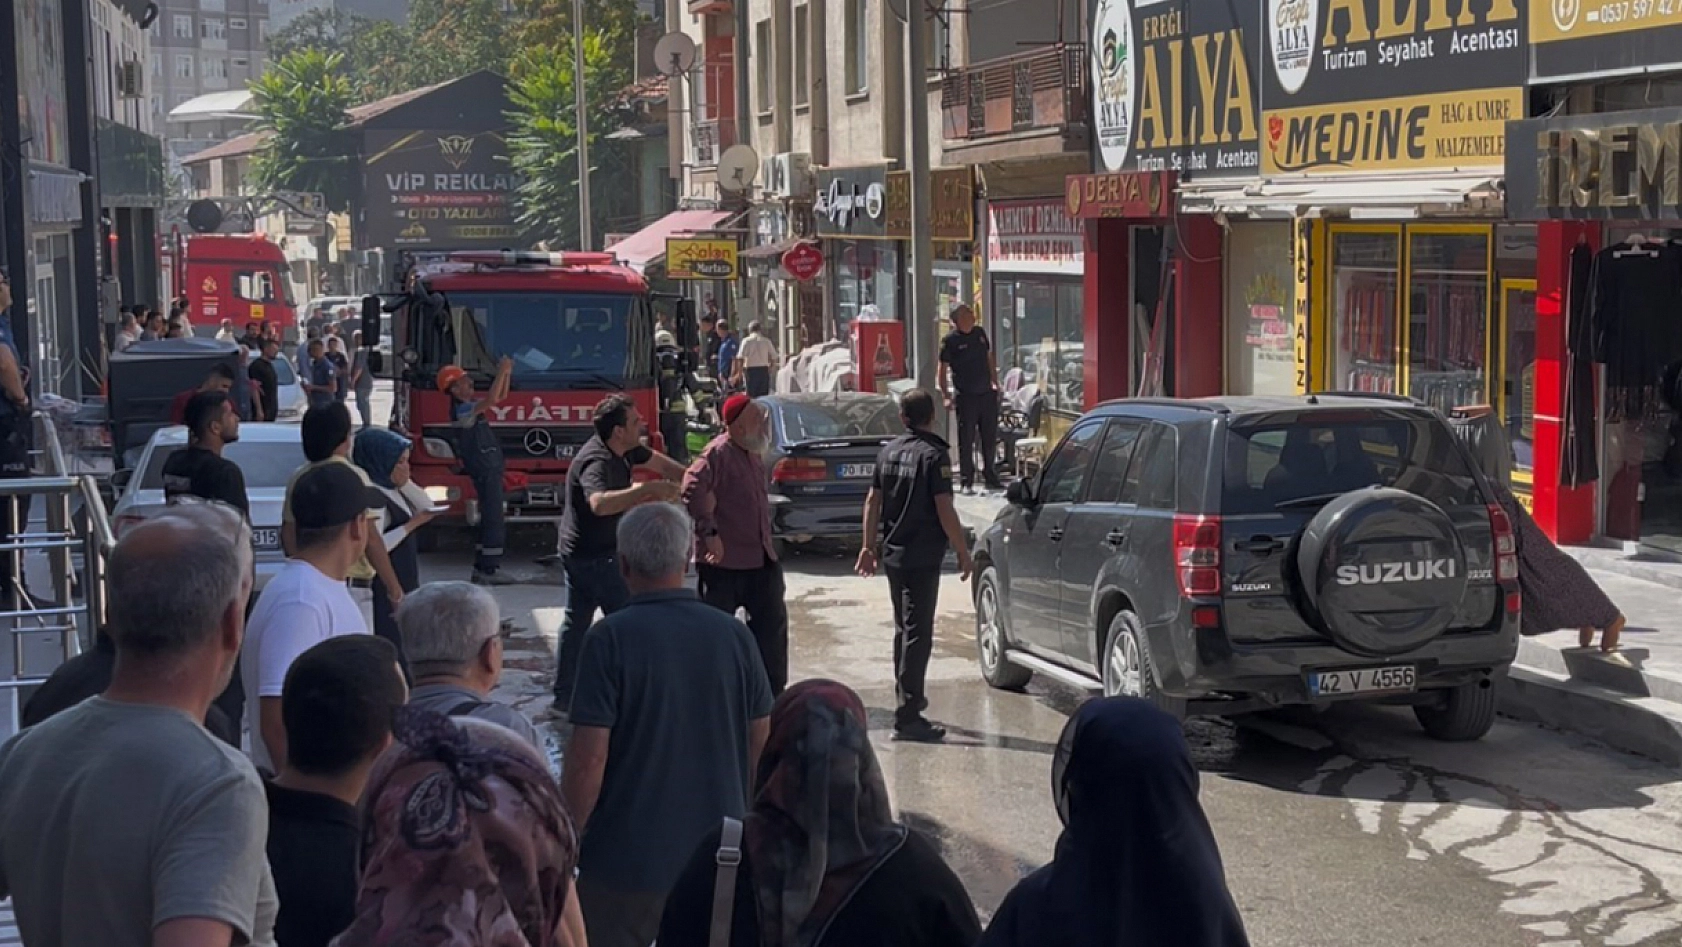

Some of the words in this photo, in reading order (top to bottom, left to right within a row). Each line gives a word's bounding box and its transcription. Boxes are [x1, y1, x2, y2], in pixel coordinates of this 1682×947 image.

[1143, 7, 1186, 41] EREĞL
[1277, 24, 1310, 51] ALYA
[1323, 48, 1367, 71] Turizm
[1378, 36, 1434, 67] Seyahat
[1450, 26, 1519, 54] Acentası
[1136, 27, 1258, 150] ALYA
[1441, 101, 1465, 124] HAC
[1476, 99, 1511, 121] UMRE
[1216, 149, 1258, 168] Acentası
[1435, 134, 1504, 159] MALZEMELE
[1085, 174, 1142, 203] DERYA
[408, 207, 439, 219] OTO
[1336, 558, 1456, 586] SUZUKI
[1231, 583, 1272, 592] SUZUKI
[1319, 672, 1341, 693] 42
[1349, 671, 1364, 690] V
[1371, 668, 1415, 689] 4556
